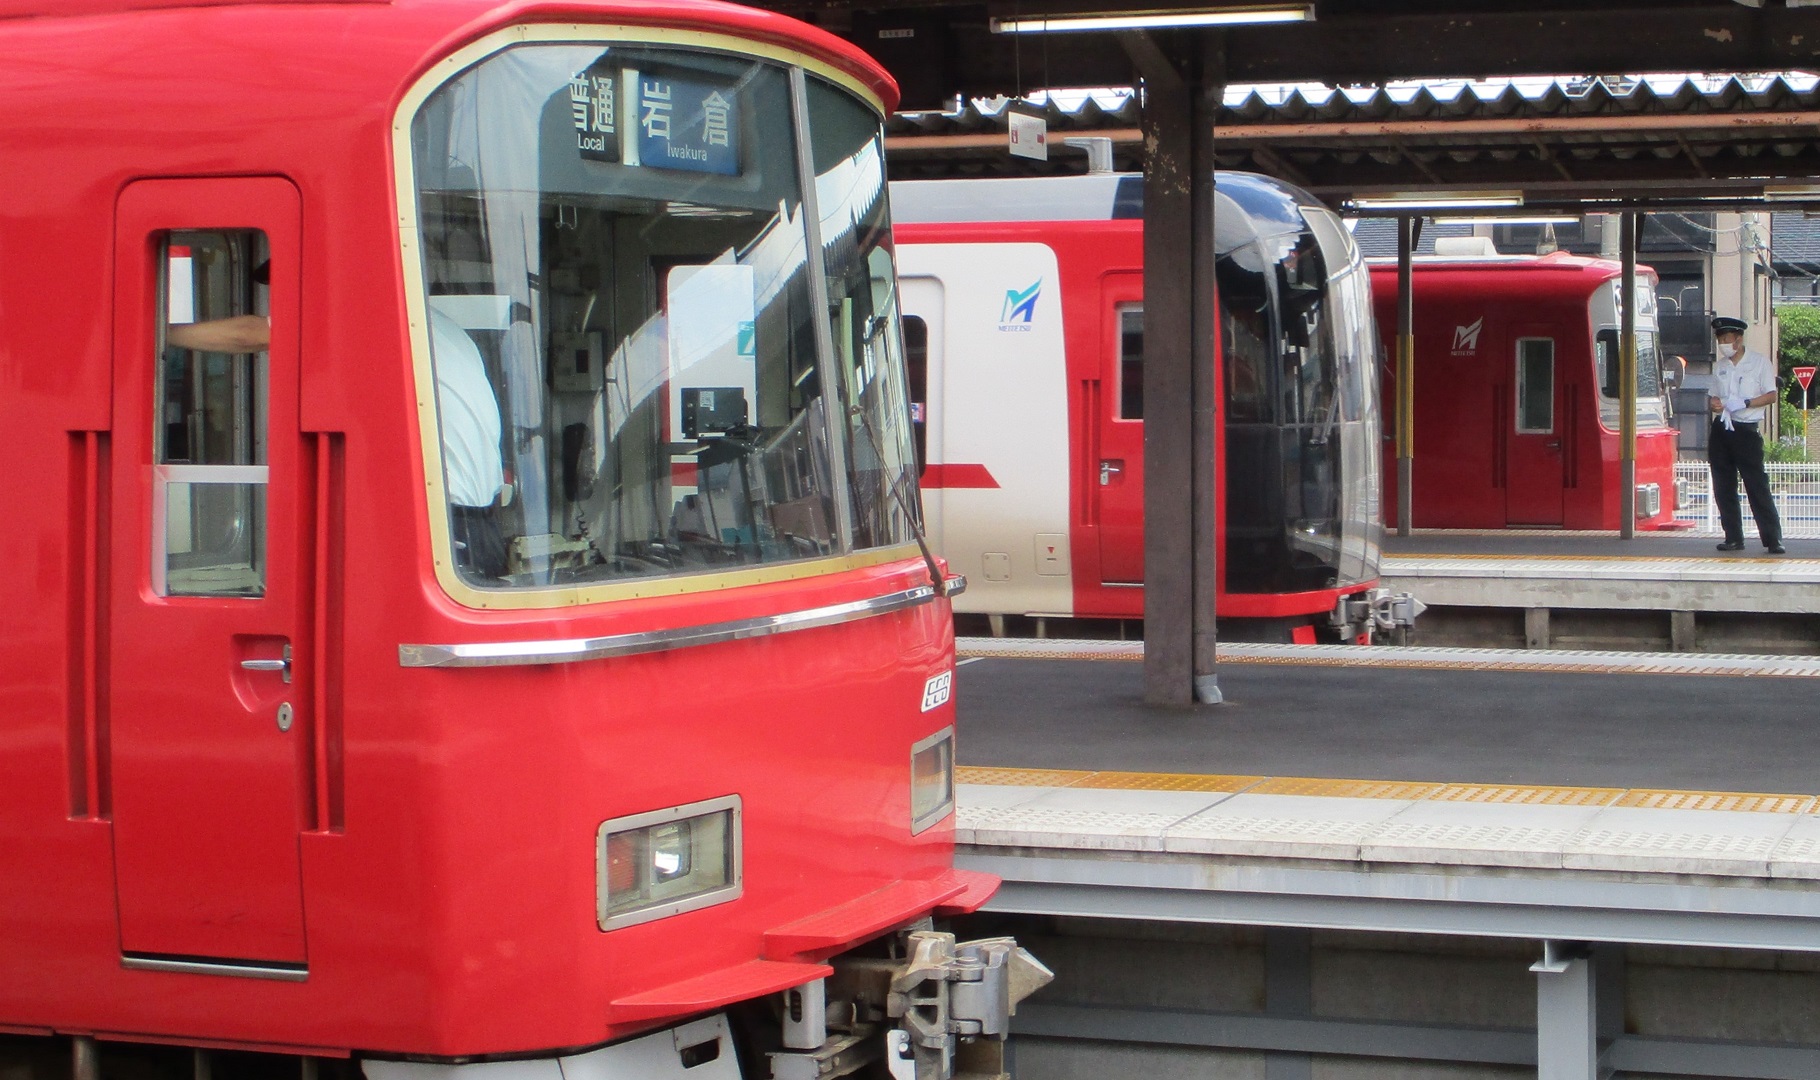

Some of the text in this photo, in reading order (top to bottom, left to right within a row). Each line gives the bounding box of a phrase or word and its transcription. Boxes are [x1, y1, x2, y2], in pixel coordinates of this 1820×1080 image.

[569, 71, 615, 134] 普通
[642, 81, 731, 148] 岩倉
[577, 133, 605, 151] Local
[667, 142, 708, 161] Iwakura
